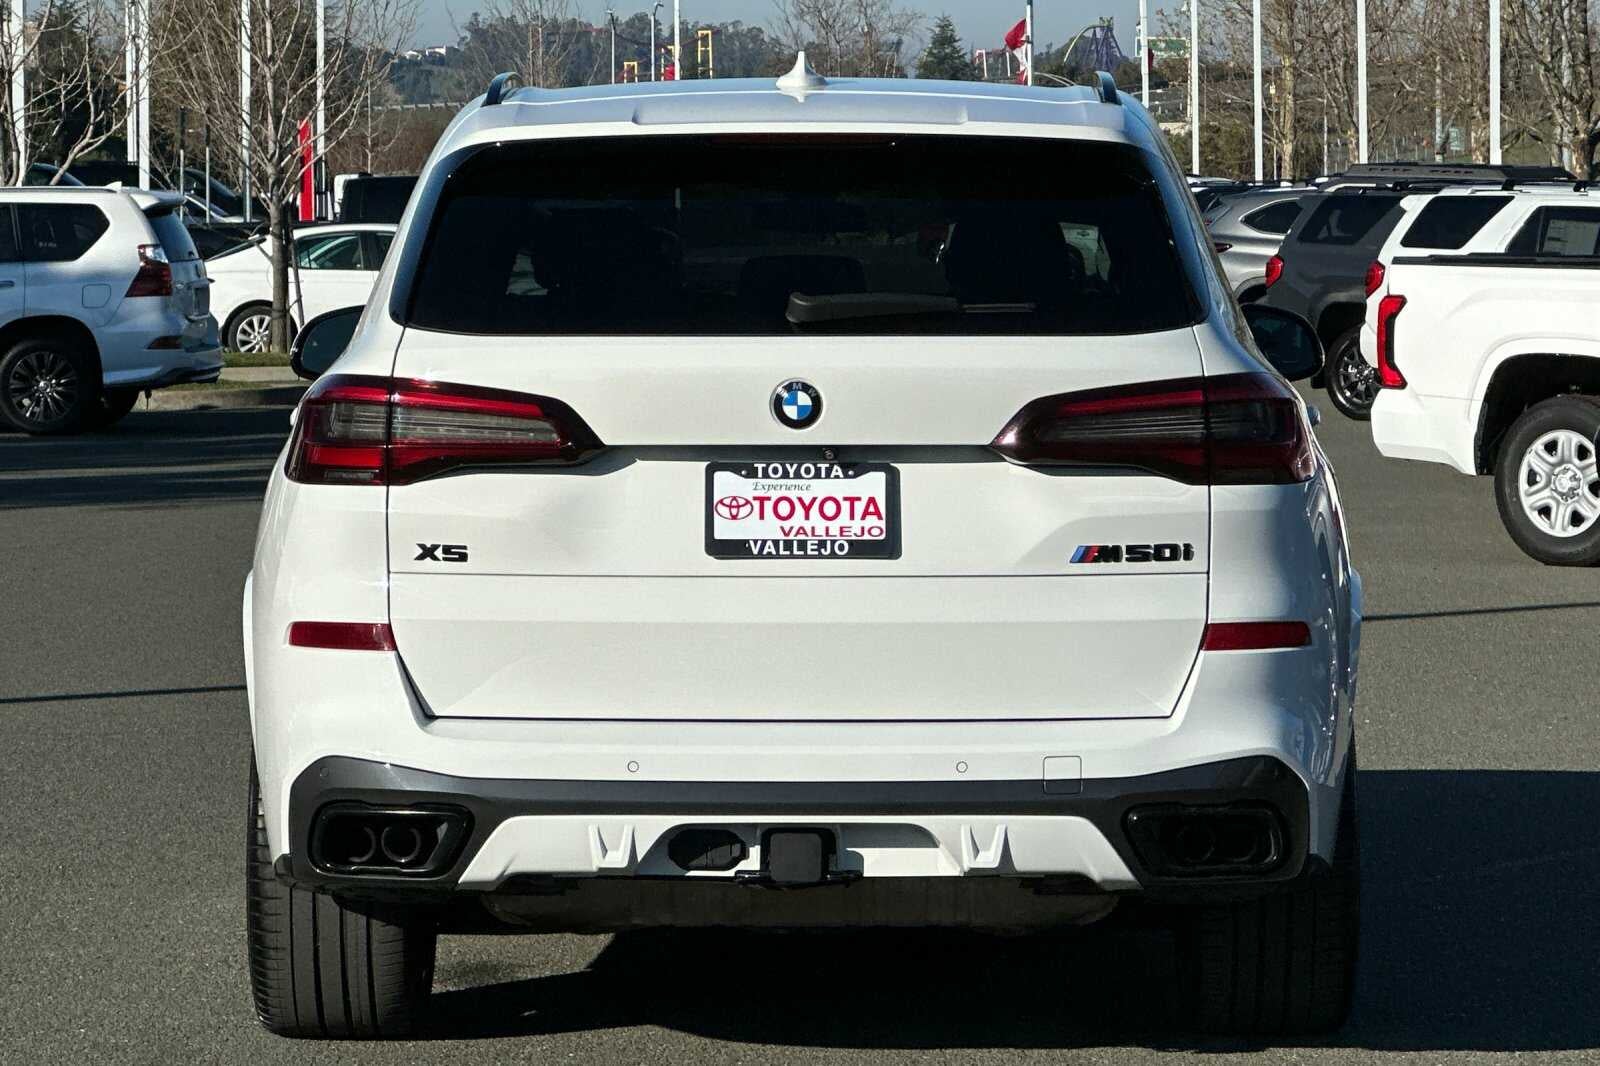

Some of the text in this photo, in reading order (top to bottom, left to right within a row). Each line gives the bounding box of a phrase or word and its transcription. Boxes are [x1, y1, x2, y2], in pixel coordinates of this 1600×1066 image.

[754, 463, 844, 478] TOYOTA
[752, 482, 812, 492] Experience
[752, 496, 884, 521] TOYOTA
[780, 526, 884, 537] VALLEJO
[414, 543, 468, 562] X5
[749, 540, 849, 555] VALLEJO
